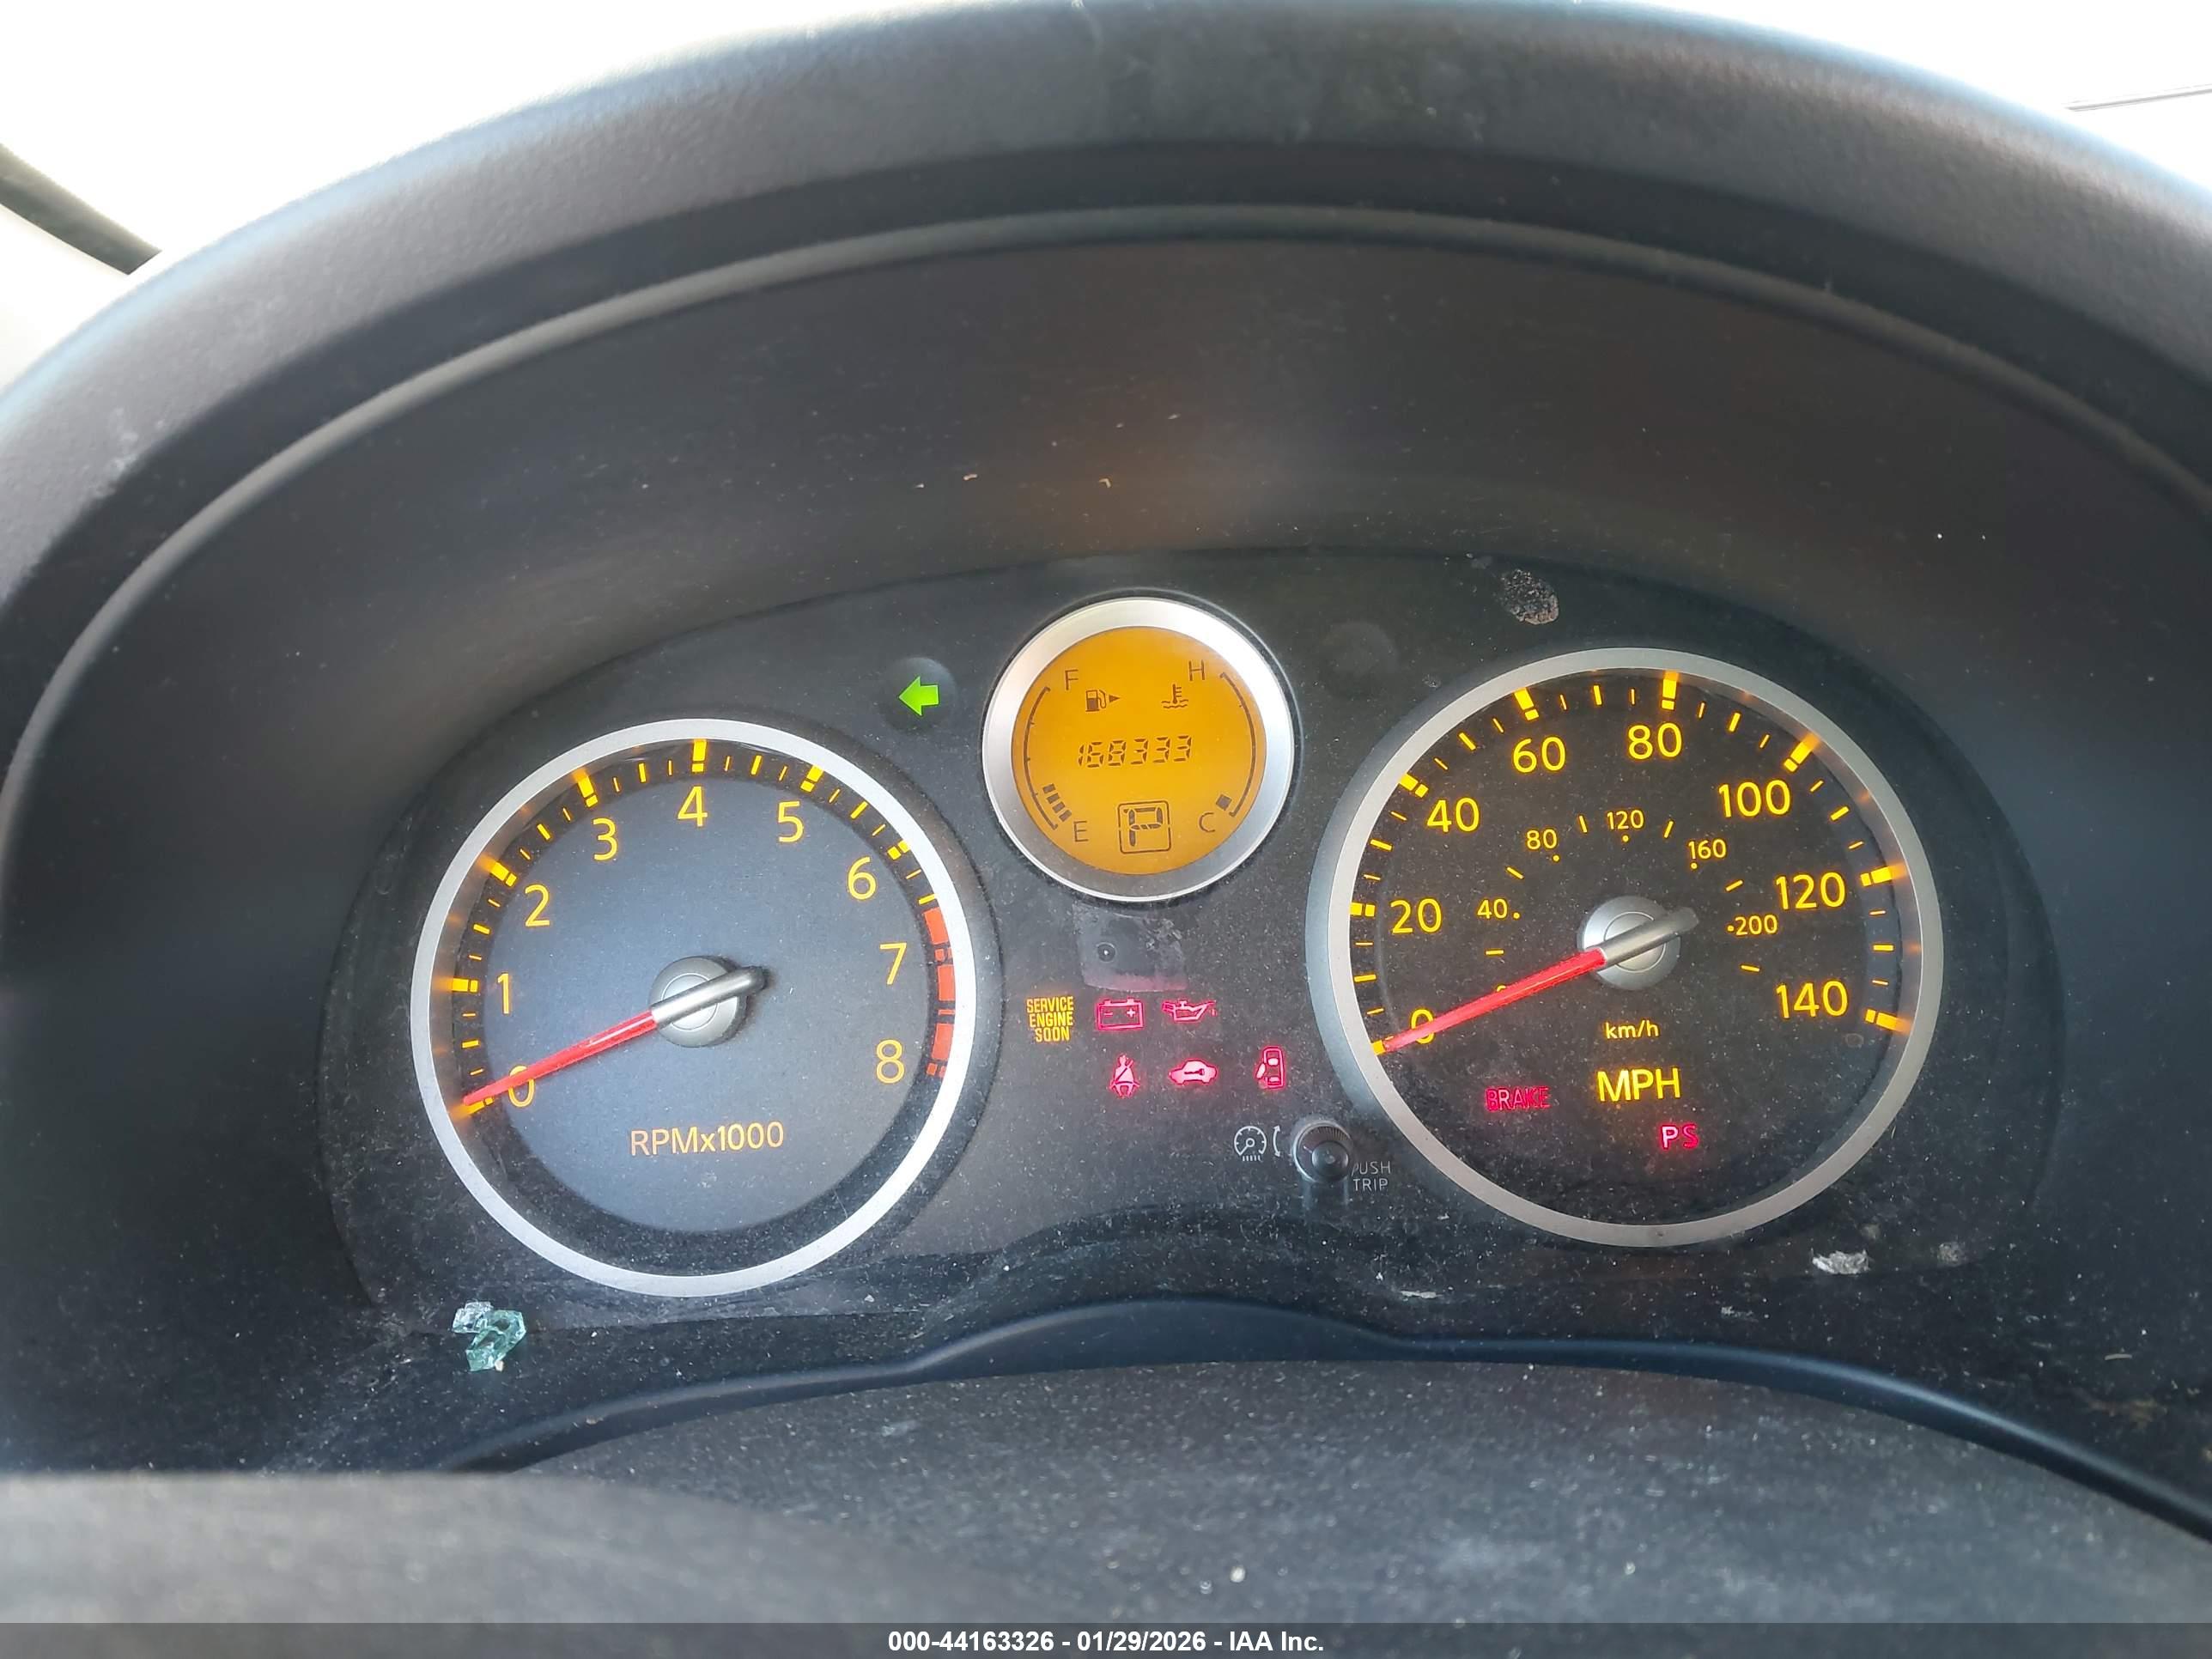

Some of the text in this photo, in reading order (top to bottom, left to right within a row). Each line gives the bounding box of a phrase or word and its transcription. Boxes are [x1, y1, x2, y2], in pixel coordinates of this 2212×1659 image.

[1064, 668, 1079, 691] F
[1188, 659, 1206, 682] H
[1078, 735, 1193, 768] 168333
[1511, 737, 1567, 774] 60
[1628, 723, 1683, 758] 80
[677, 785, 708, 827] 4
[1425, 797, 1480, 833] 40
[1718, 780, 1791, 818] 100
[776, 800, 804, 843] 5
[1074, 820, 1090, 843] E
[1122, 805, 1164, 848] P
[1199, 811, 1216, 833] C
[1607, 809, 1645, 830] 120
[592, 817, 618, 860] 3
[1525, 829, 1559, 850] 80
[1687, 838, 1728, 861] 160
[847, 856, 877, 901] 6
[1775, 872, 1846, 910] 120
[524, 884, 550, 927] 2
[1389, 899, 1443, 934] 20
[1476, 898, 1509, 921] 40
[1735, 914, 1778, 936] 200
[879, 942, 908, 985] 7
[497, 972, 511, 1014] 1
[1026, 996, 1074, 1013] SERVICE
[1776, 981, 1849, 1019] 140
[1029, 1011, 1073, 1028] ENGINE
[1035, 1026, 1070, 1042] SOON
[1410, 1008, 1435, 1044] 0
[1604, 1019, 1660, 1041] km/h
[875, 1039, 905, 1084] 8
[507, 1065, 535, 1108] 0
[1485, 1085, 1551, 1111] BRAKE
[1595, 1067, 1681, 1103] MPH
[629, 1120, 785, 1157] RPMx1000
[1661, 1123, 1698, 1149] PS
[1352, 1161, 1391, 1176] PUSH
[1352, 1177, 1389, 1192] TRIP
